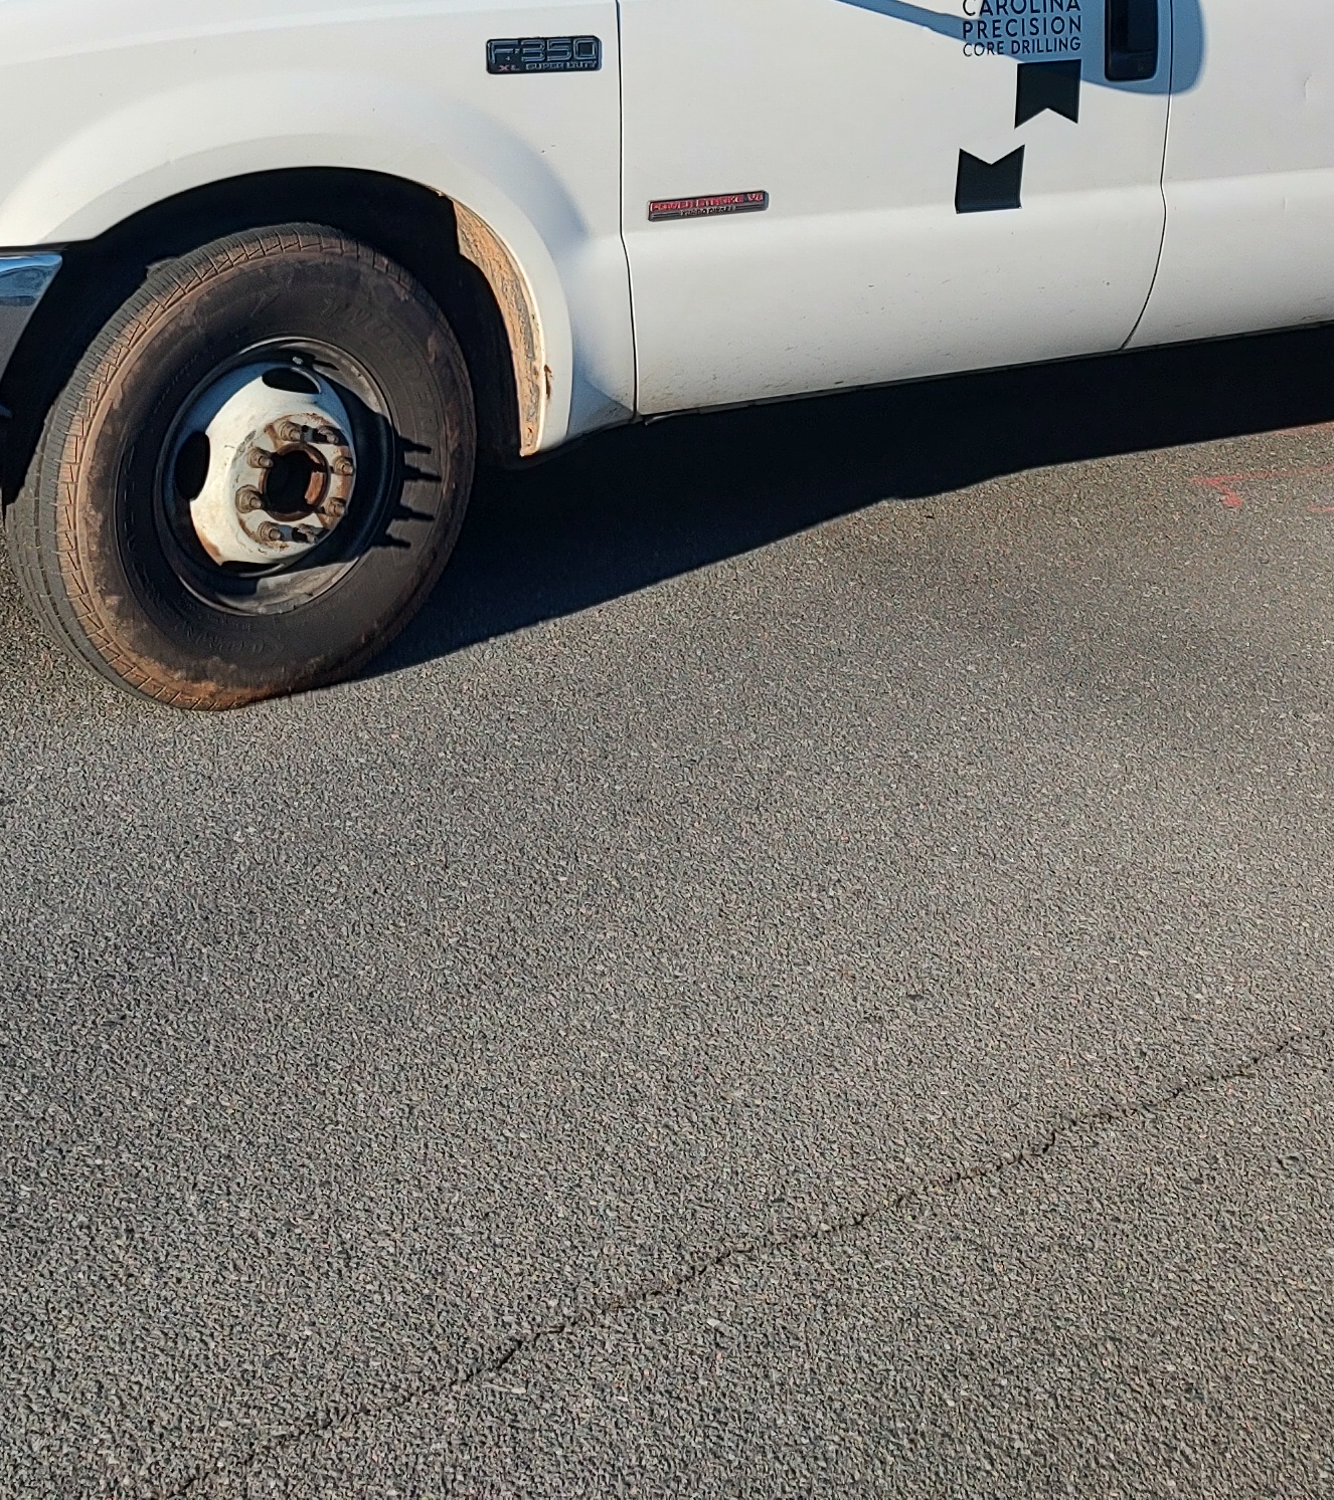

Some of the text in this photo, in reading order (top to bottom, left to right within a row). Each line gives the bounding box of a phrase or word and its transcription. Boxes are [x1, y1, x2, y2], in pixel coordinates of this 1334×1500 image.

[962, 15, 1082, 40] PRECISION
[962, 36, 1081, 57] CORE DRILLING
[525, 62, 565, 71] SUPER
[567, 60, 598, 69] DUTY
